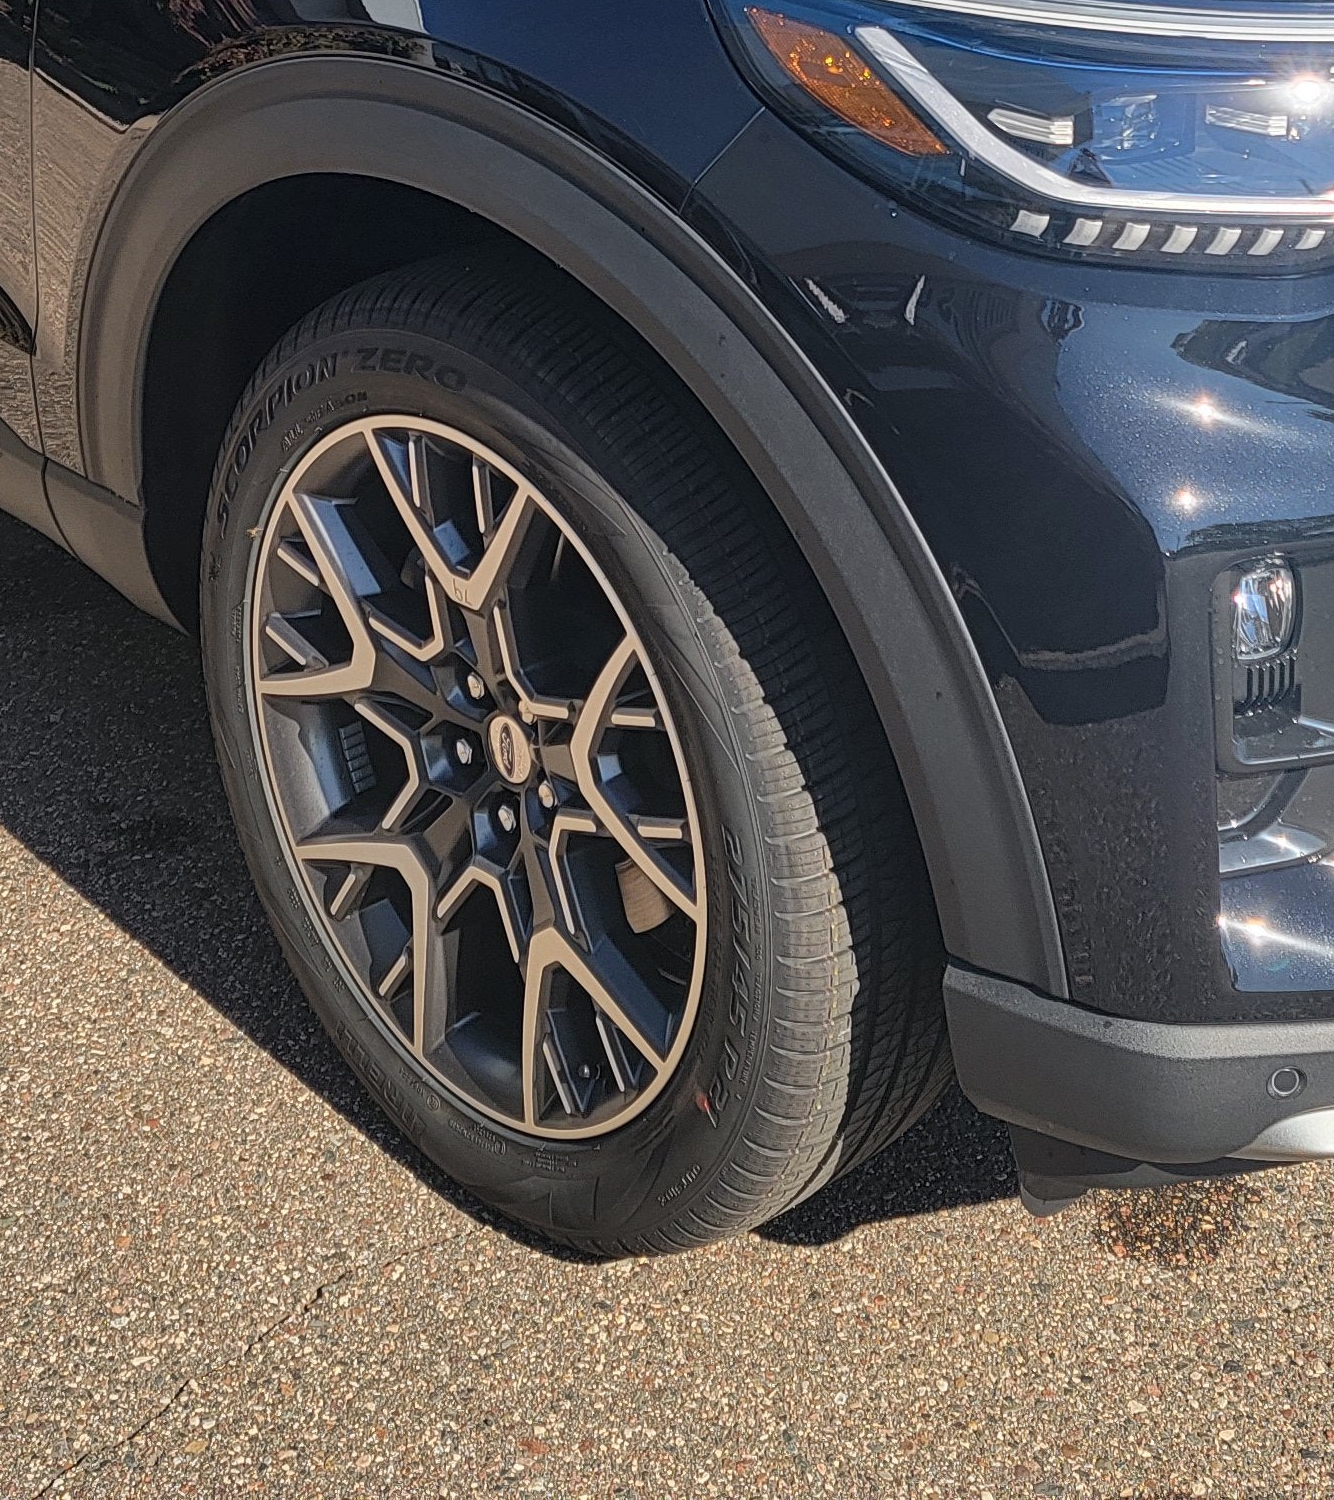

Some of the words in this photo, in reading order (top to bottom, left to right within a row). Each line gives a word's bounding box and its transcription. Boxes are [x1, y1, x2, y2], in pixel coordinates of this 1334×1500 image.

[218, 351, 339, 540] SCORPION
[352, 346, 469, 394] ZERO
[719, 824, 750, 1038] 275/45
